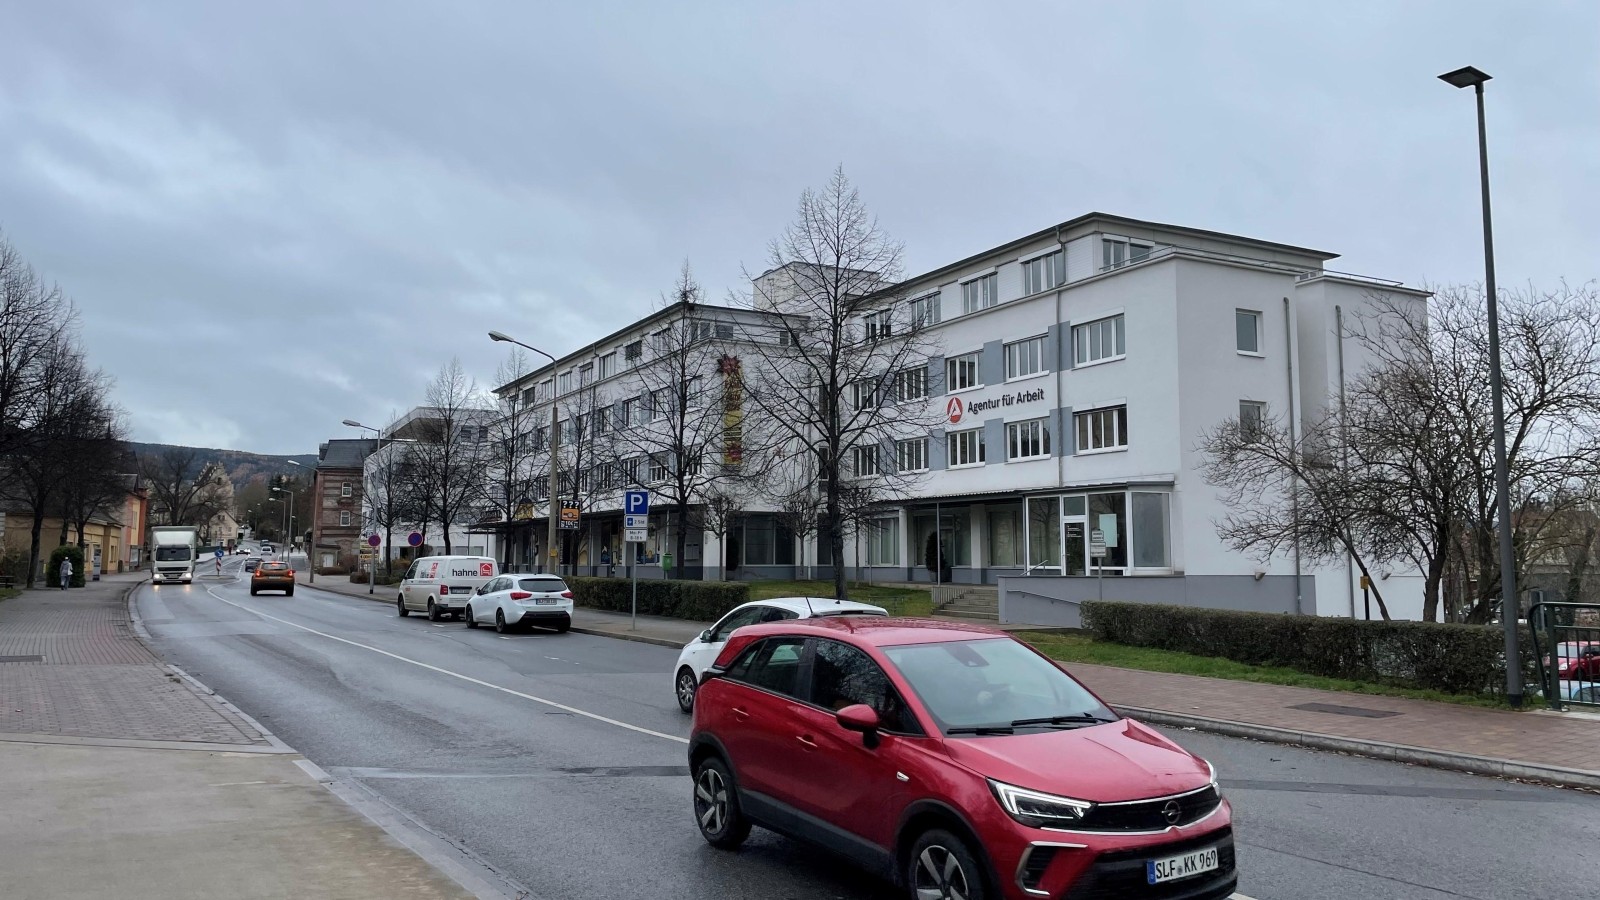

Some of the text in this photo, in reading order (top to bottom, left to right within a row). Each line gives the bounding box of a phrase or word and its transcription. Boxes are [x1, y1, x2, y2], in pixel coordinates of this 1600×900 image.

[968, 388, 1044, 415] Agentur für Arbeit
[630, 494, 643, 512] P
[452, 569, 477, 577] hahne
[1156, 850, 1217, 879] SLF KK 969
